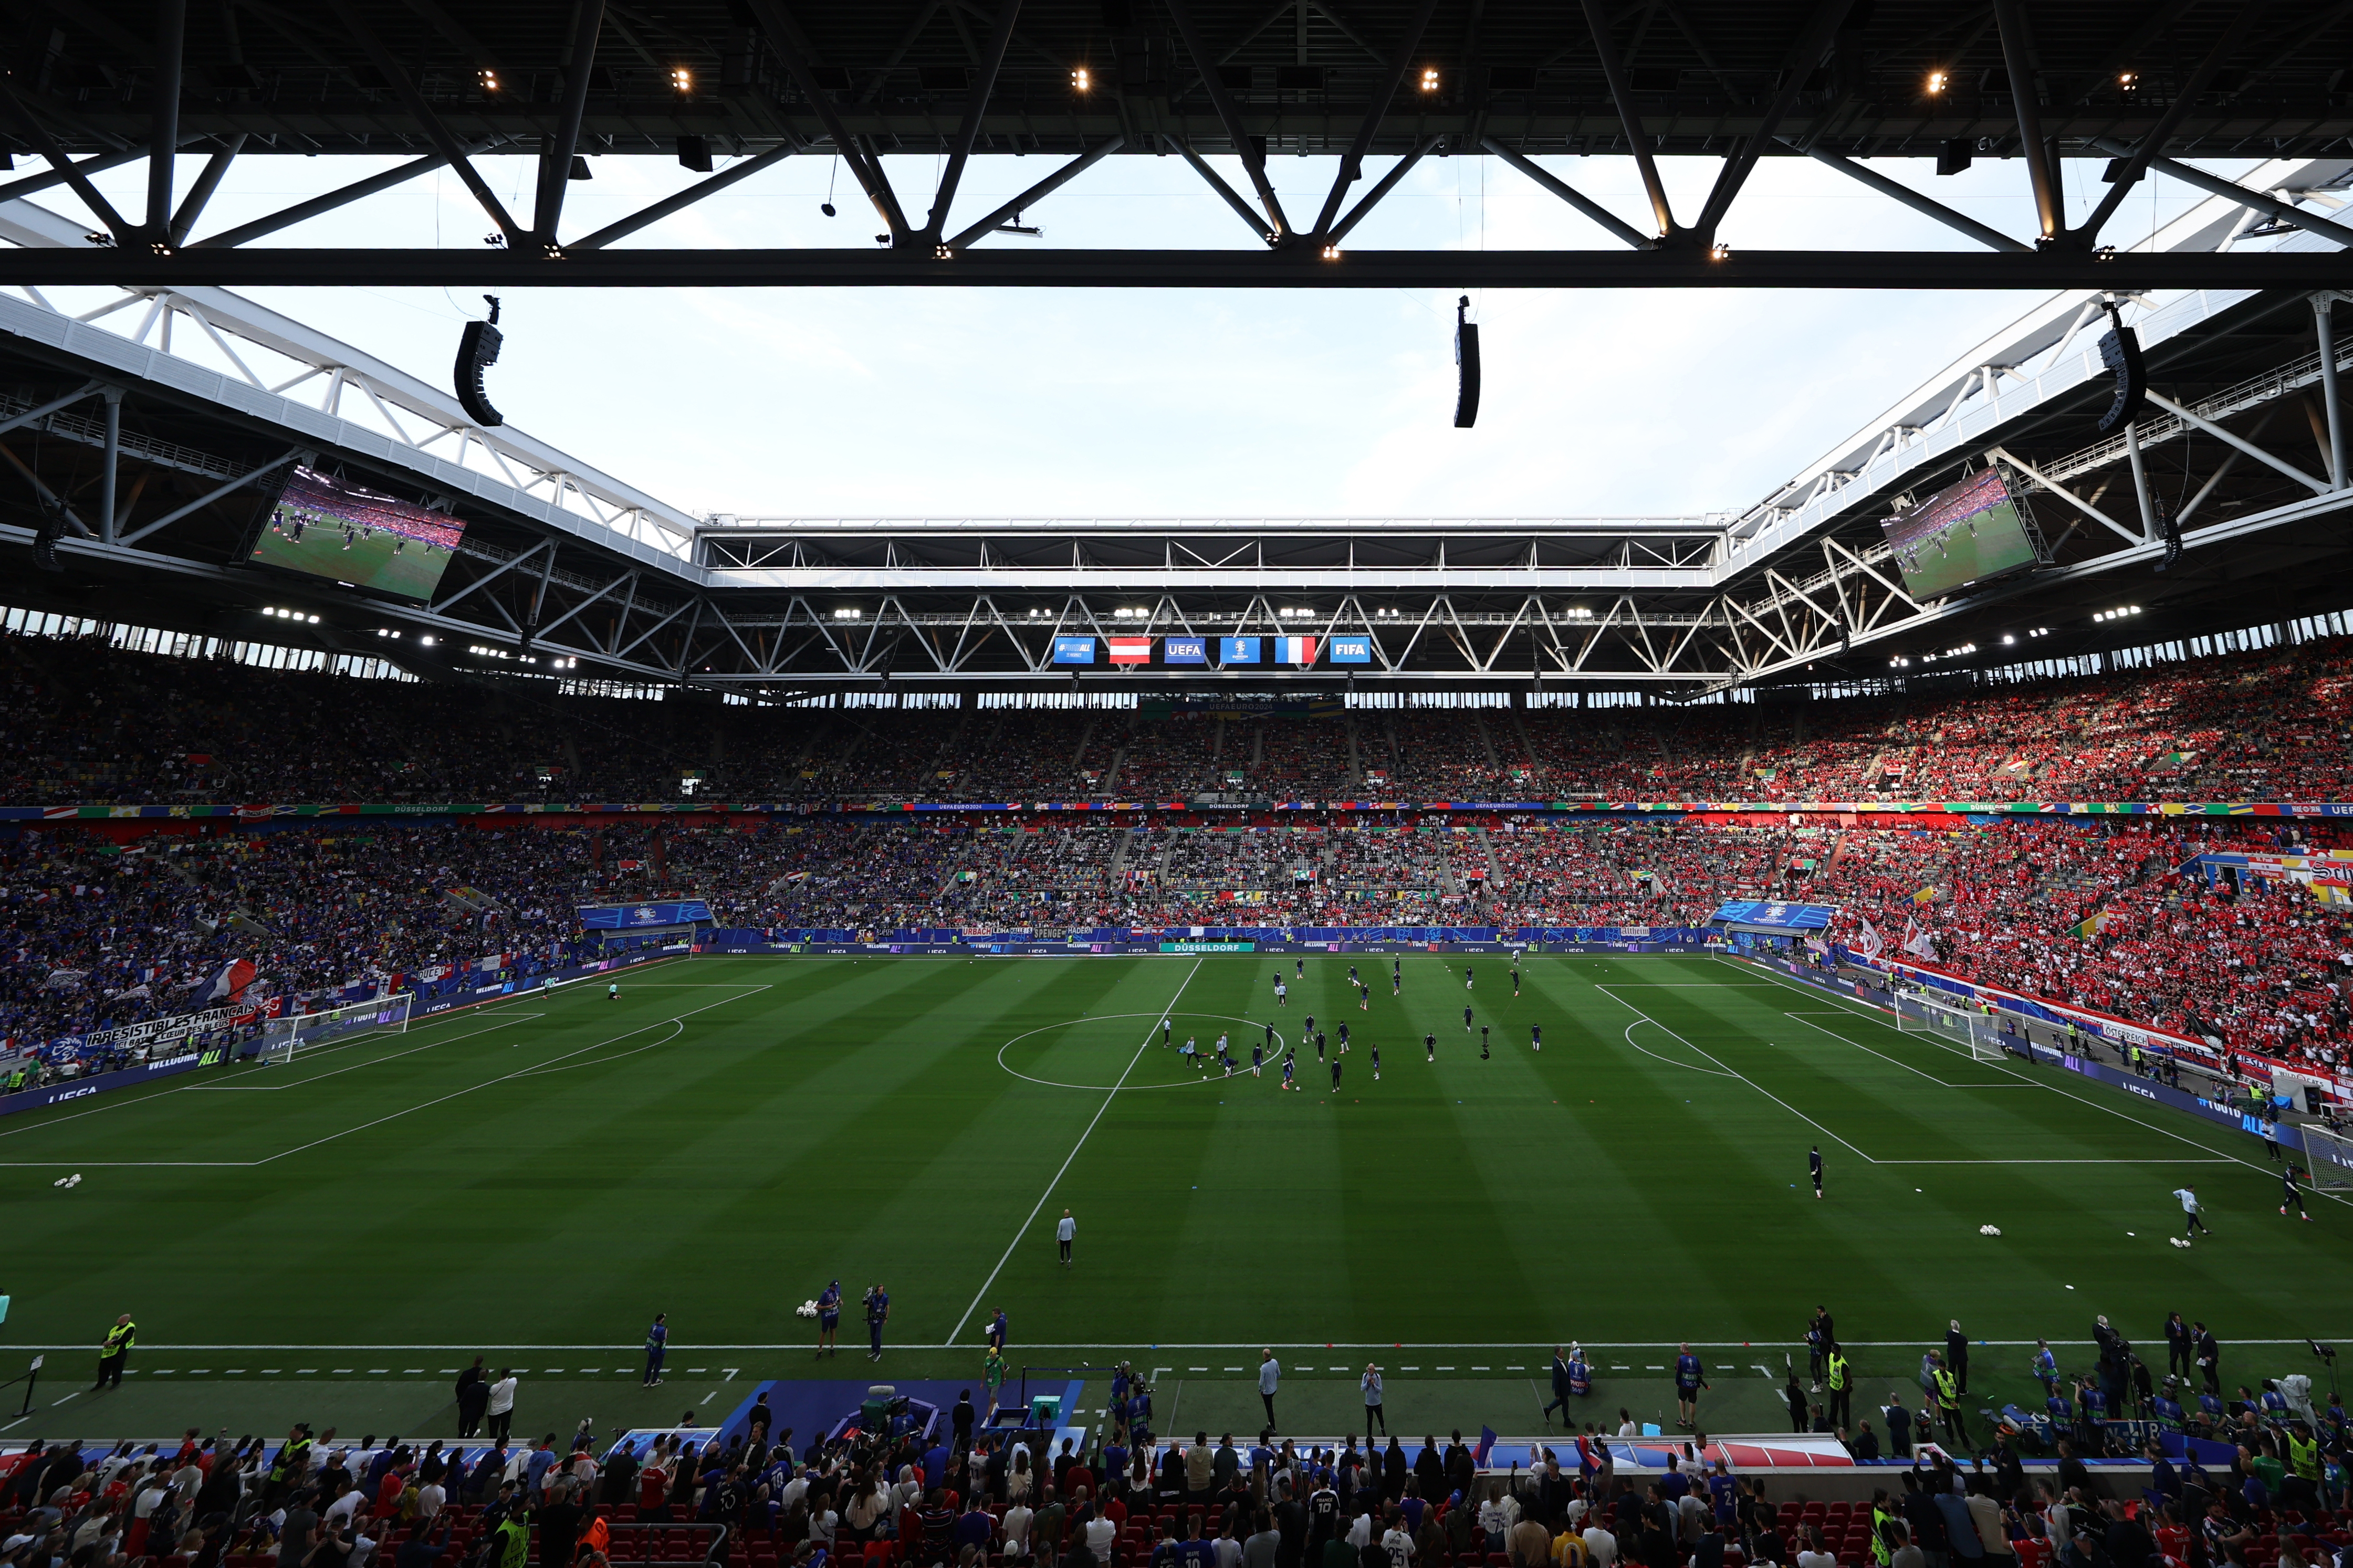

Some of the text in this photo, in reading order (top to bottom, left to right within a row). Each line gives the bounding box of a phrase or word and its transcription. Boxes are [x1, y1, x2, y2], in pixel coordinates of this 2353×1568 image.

[1168, 645, 1201, 655] UEFA
[1336, 644, 1365, 655] FIFA
[963, 927, 992, 935] URBACH
[1034, 928, 1061, 938] SPENGE
[1621, 927, 1649, 936] Altheim
[689, 944, 702, 953] ALL
[890, 945, 901, 953] ALL
[1091, 944, 1102, 953] ALL
[1175, 943, 1239, 952] DÜSSELDORF
[1327, 943, 1339, 952] ALL
[1527, 943, 1539, 952] ALL
[1727, 945, 1739, 953] ALL
[419, 966, 445, 979] DUCEY
[501, 982, 515, 994] ALL
[1856, 985, 1864, 996] ALL
[85, 1014, 190, 1047] IRRESISTIBLES
[115, 1040, 127, 1050] ICI
[204, 1019, 229, 1030] BLEUS
[2106, 1026, 2147, 1045] ÖSTERREICH
[197, 1049, 222, 1067] ALL
[2064, 1054, 2080, 1072] ALL
[2307, 1078, 2324, 1087] CATS
[1570, 1379, 1585, 1387] PHOTO
[970, 1467, 980, 1480] 11
[772, 1471, 783, 1491] 10
[720, 1494, 736, 1512] 10
[1724, 1491, 1732, 1506] 2
[1318, 1503, 1332, 1513] 10
[1492, 1518, 1500, 1534] 7
[1387, 1546, 1404, 1567] 25
[2181, 1544, 2189, 1562] 4
[1185, 1558, 1201, 1568] 10
